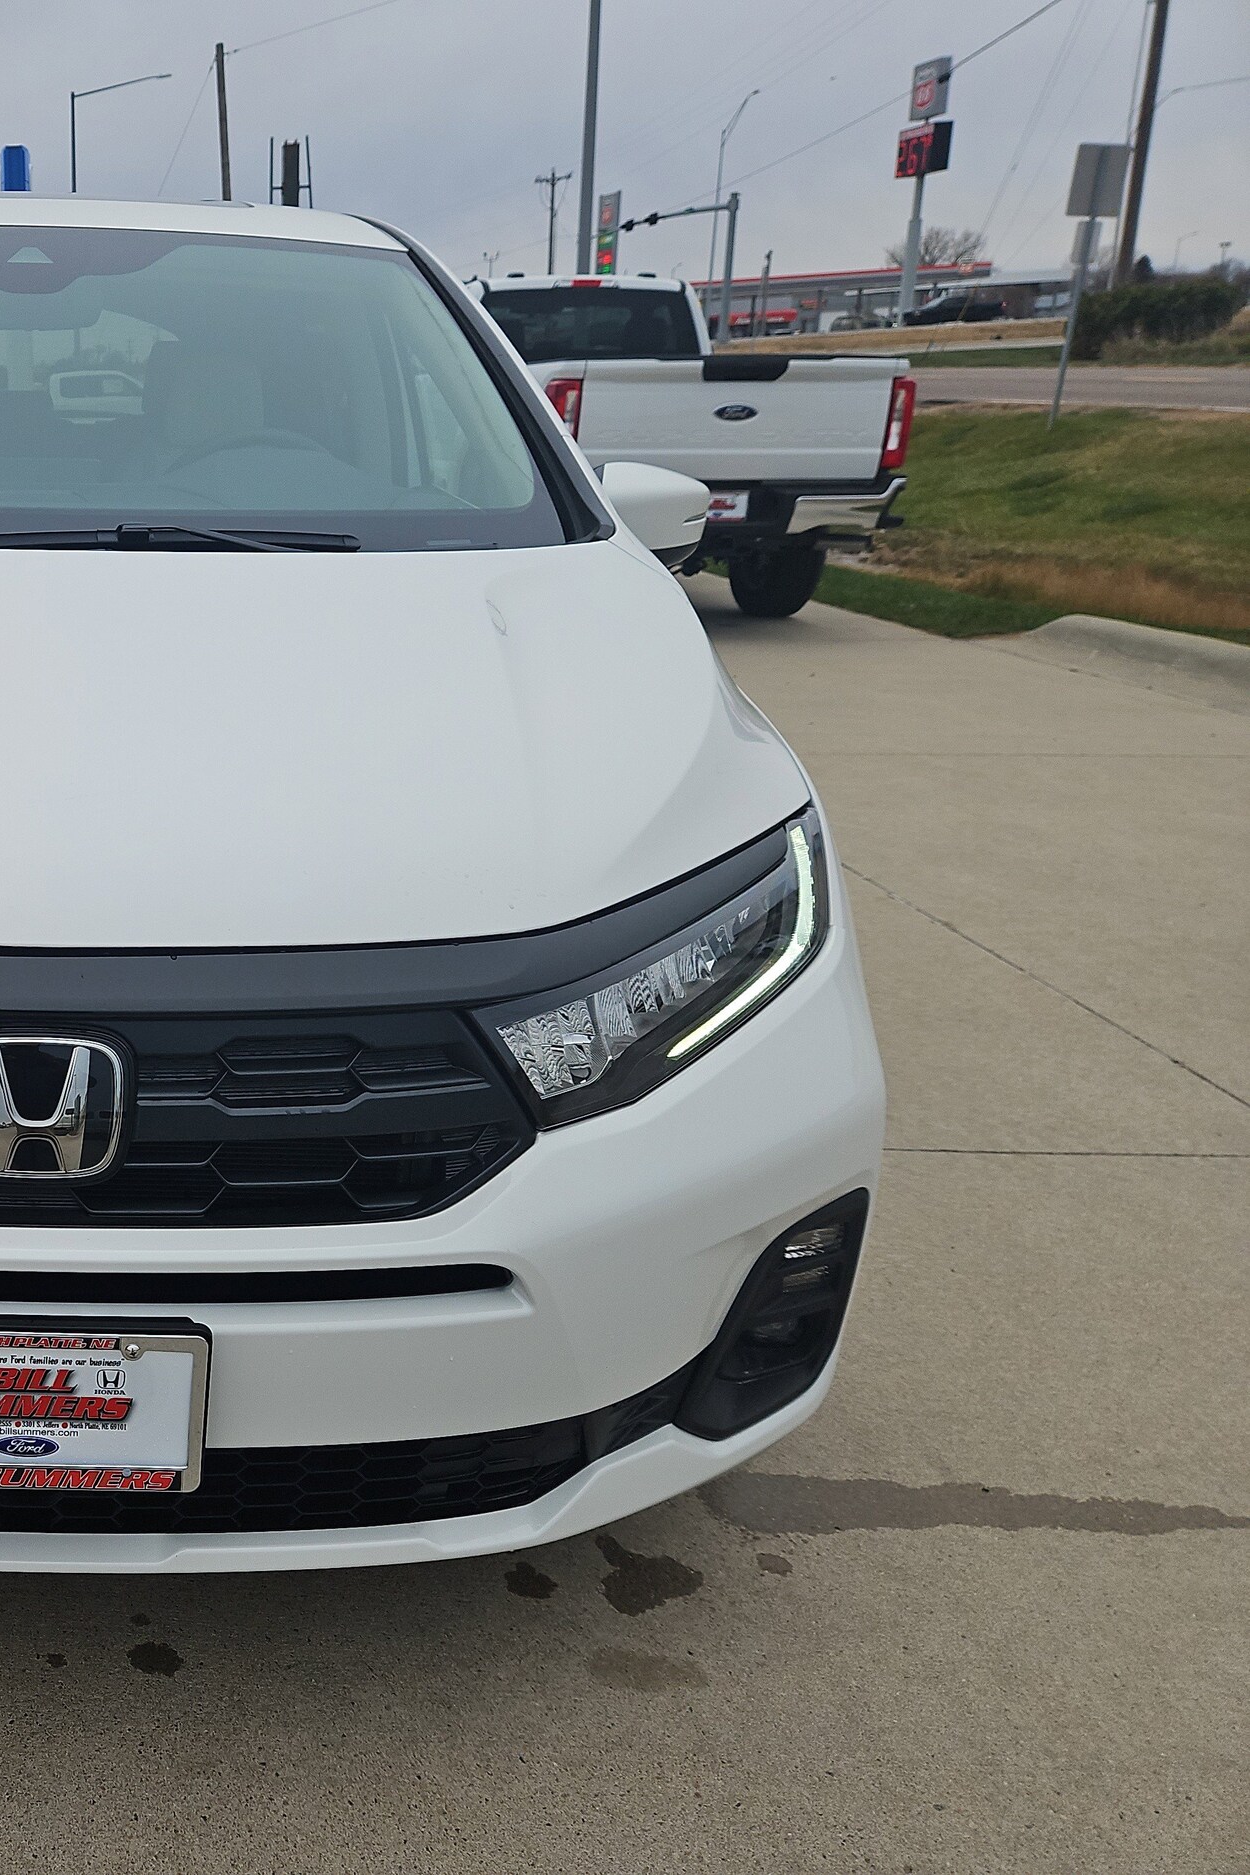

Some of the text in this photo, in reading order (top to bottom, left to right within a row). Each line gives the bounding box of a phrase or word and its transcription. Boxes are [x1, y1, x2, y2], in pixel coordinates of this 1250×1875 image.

[89, 1338, 117, 1349] NE
[11, 1355, 26, 1364] Ford
[30, 1356, 58, 1365] families
[61, 1358, 72, 1366] are
[22, 1420, 35, 1428] 3301
[69, 1422, 83, 1430] North
[101, 1422, 109, 1430] NE
[109, 1422, 127, 1431] 69101
[6, 1439, 46, 1453] Ford
